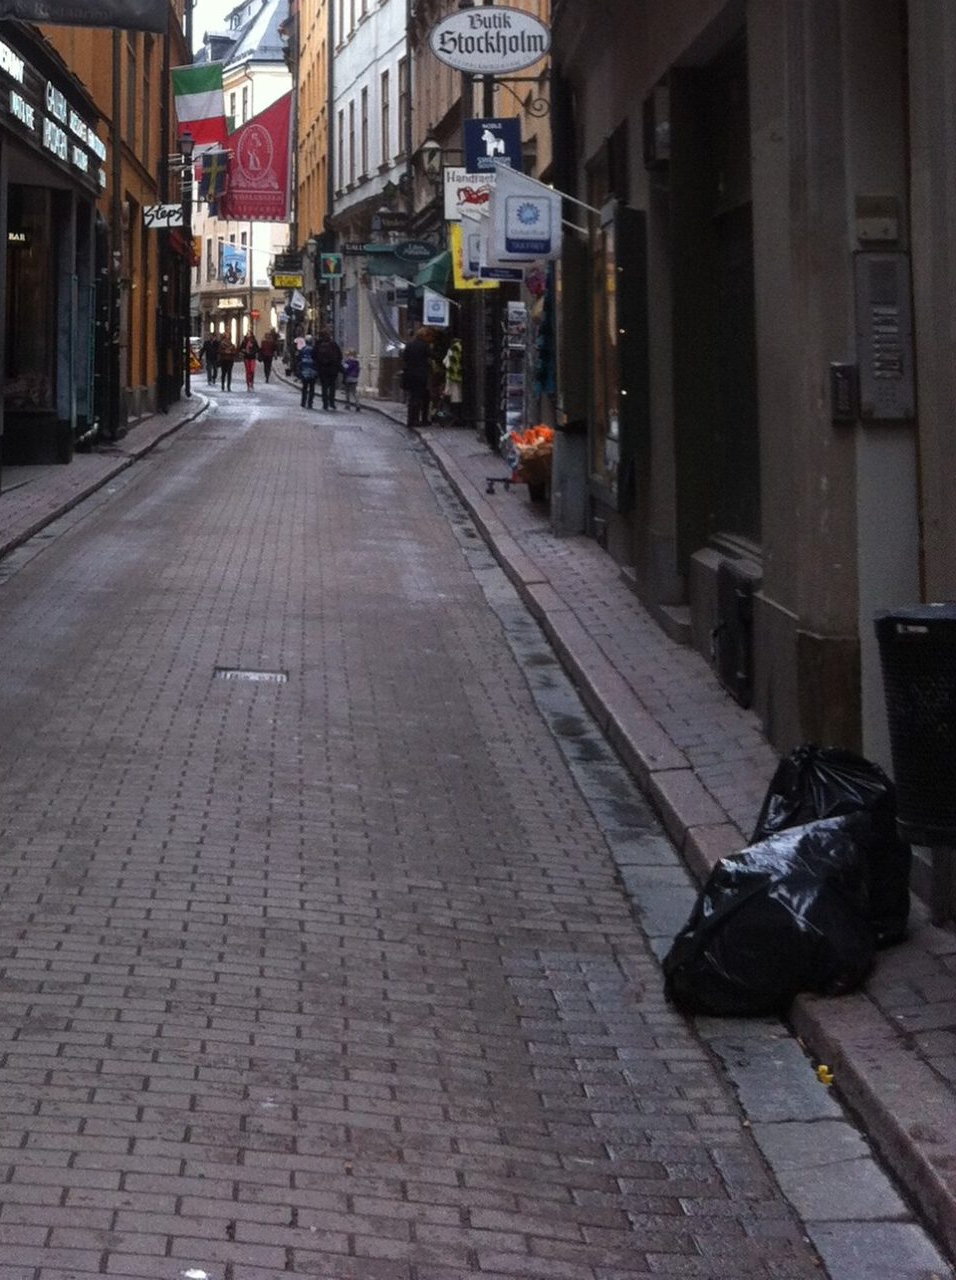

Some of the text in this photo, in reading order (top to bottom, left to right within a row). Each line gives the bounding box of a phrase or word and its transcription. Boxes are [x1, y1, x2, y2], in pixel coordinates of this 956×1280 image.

[468, 13, 512, 30] Butik
[438, 30, 545, 57] Stockholm
[144, 204, 183, 228] Steps
[8, 232, 26, 241] BAR
